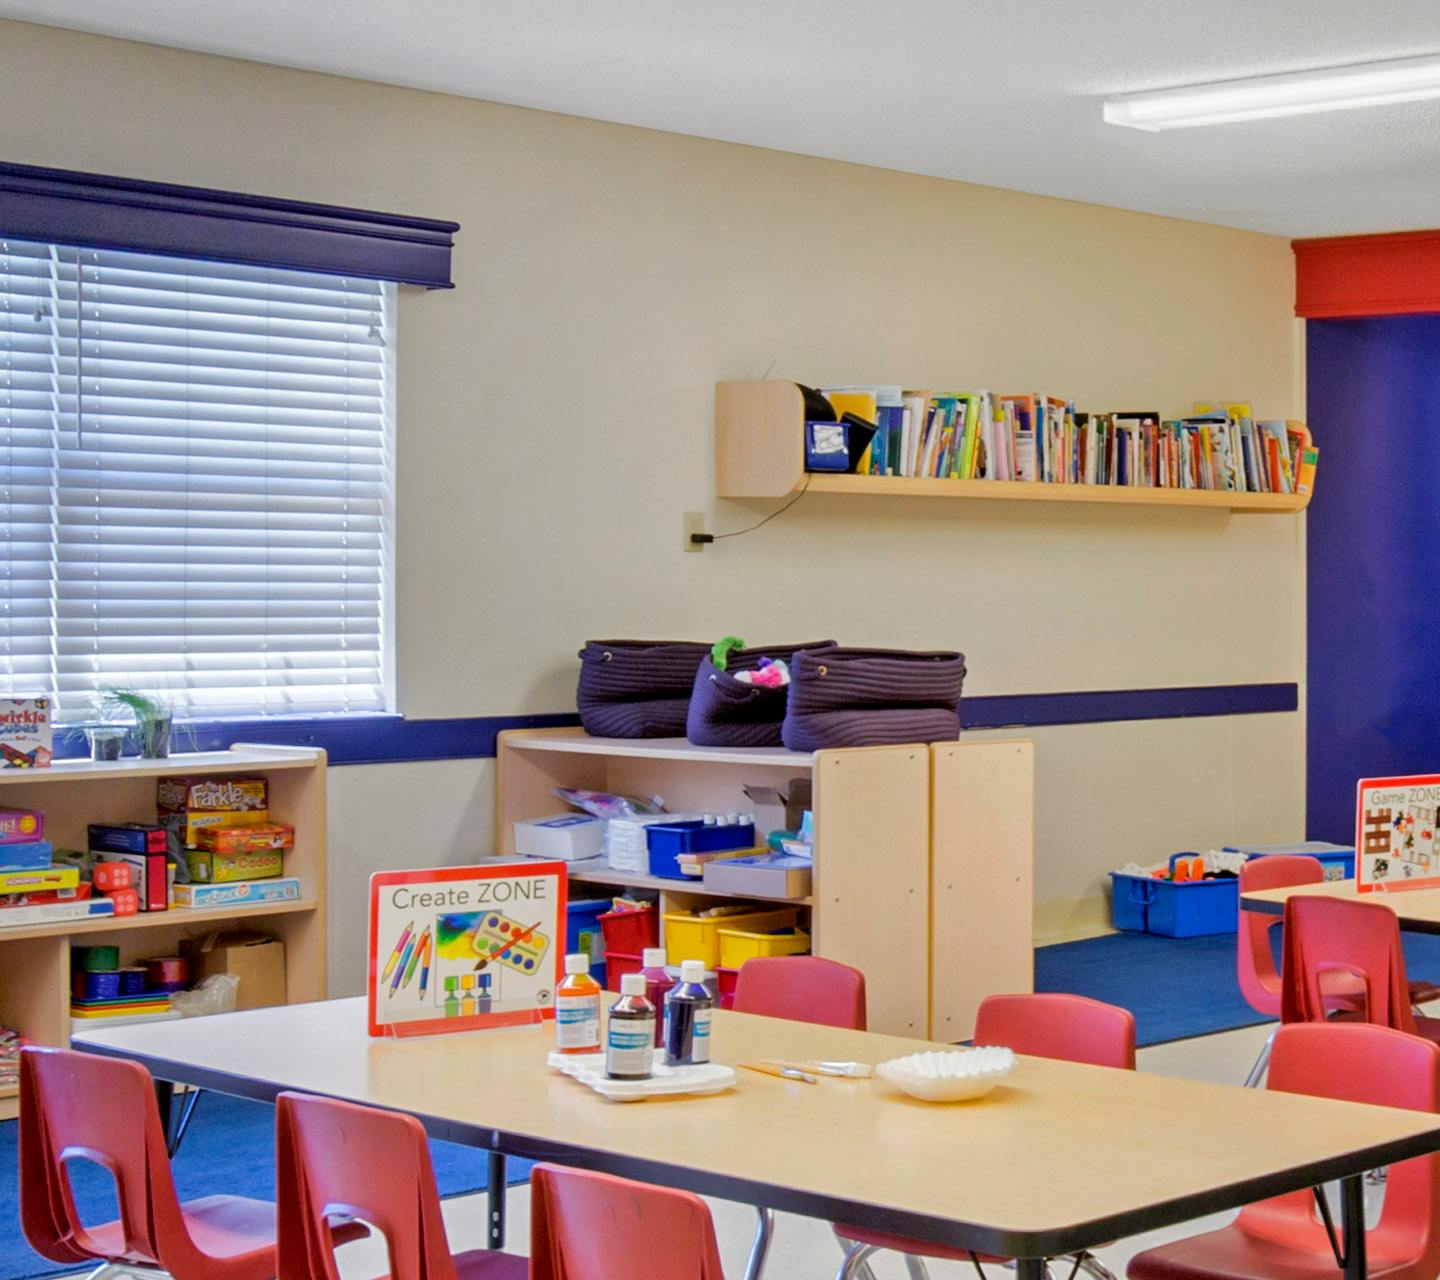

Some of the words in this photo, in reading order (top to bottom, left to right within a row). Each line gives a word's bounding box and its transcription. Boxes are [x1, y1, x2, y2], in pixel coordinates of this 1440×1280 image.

[190, 782, 242, 808] Farkle
[1371, 790, 1405, 806] Game
[237, 857, 278, 869] Cadoo
[392, 888, 470, 909] Create
[477, 879, 546, 903] ZONE
